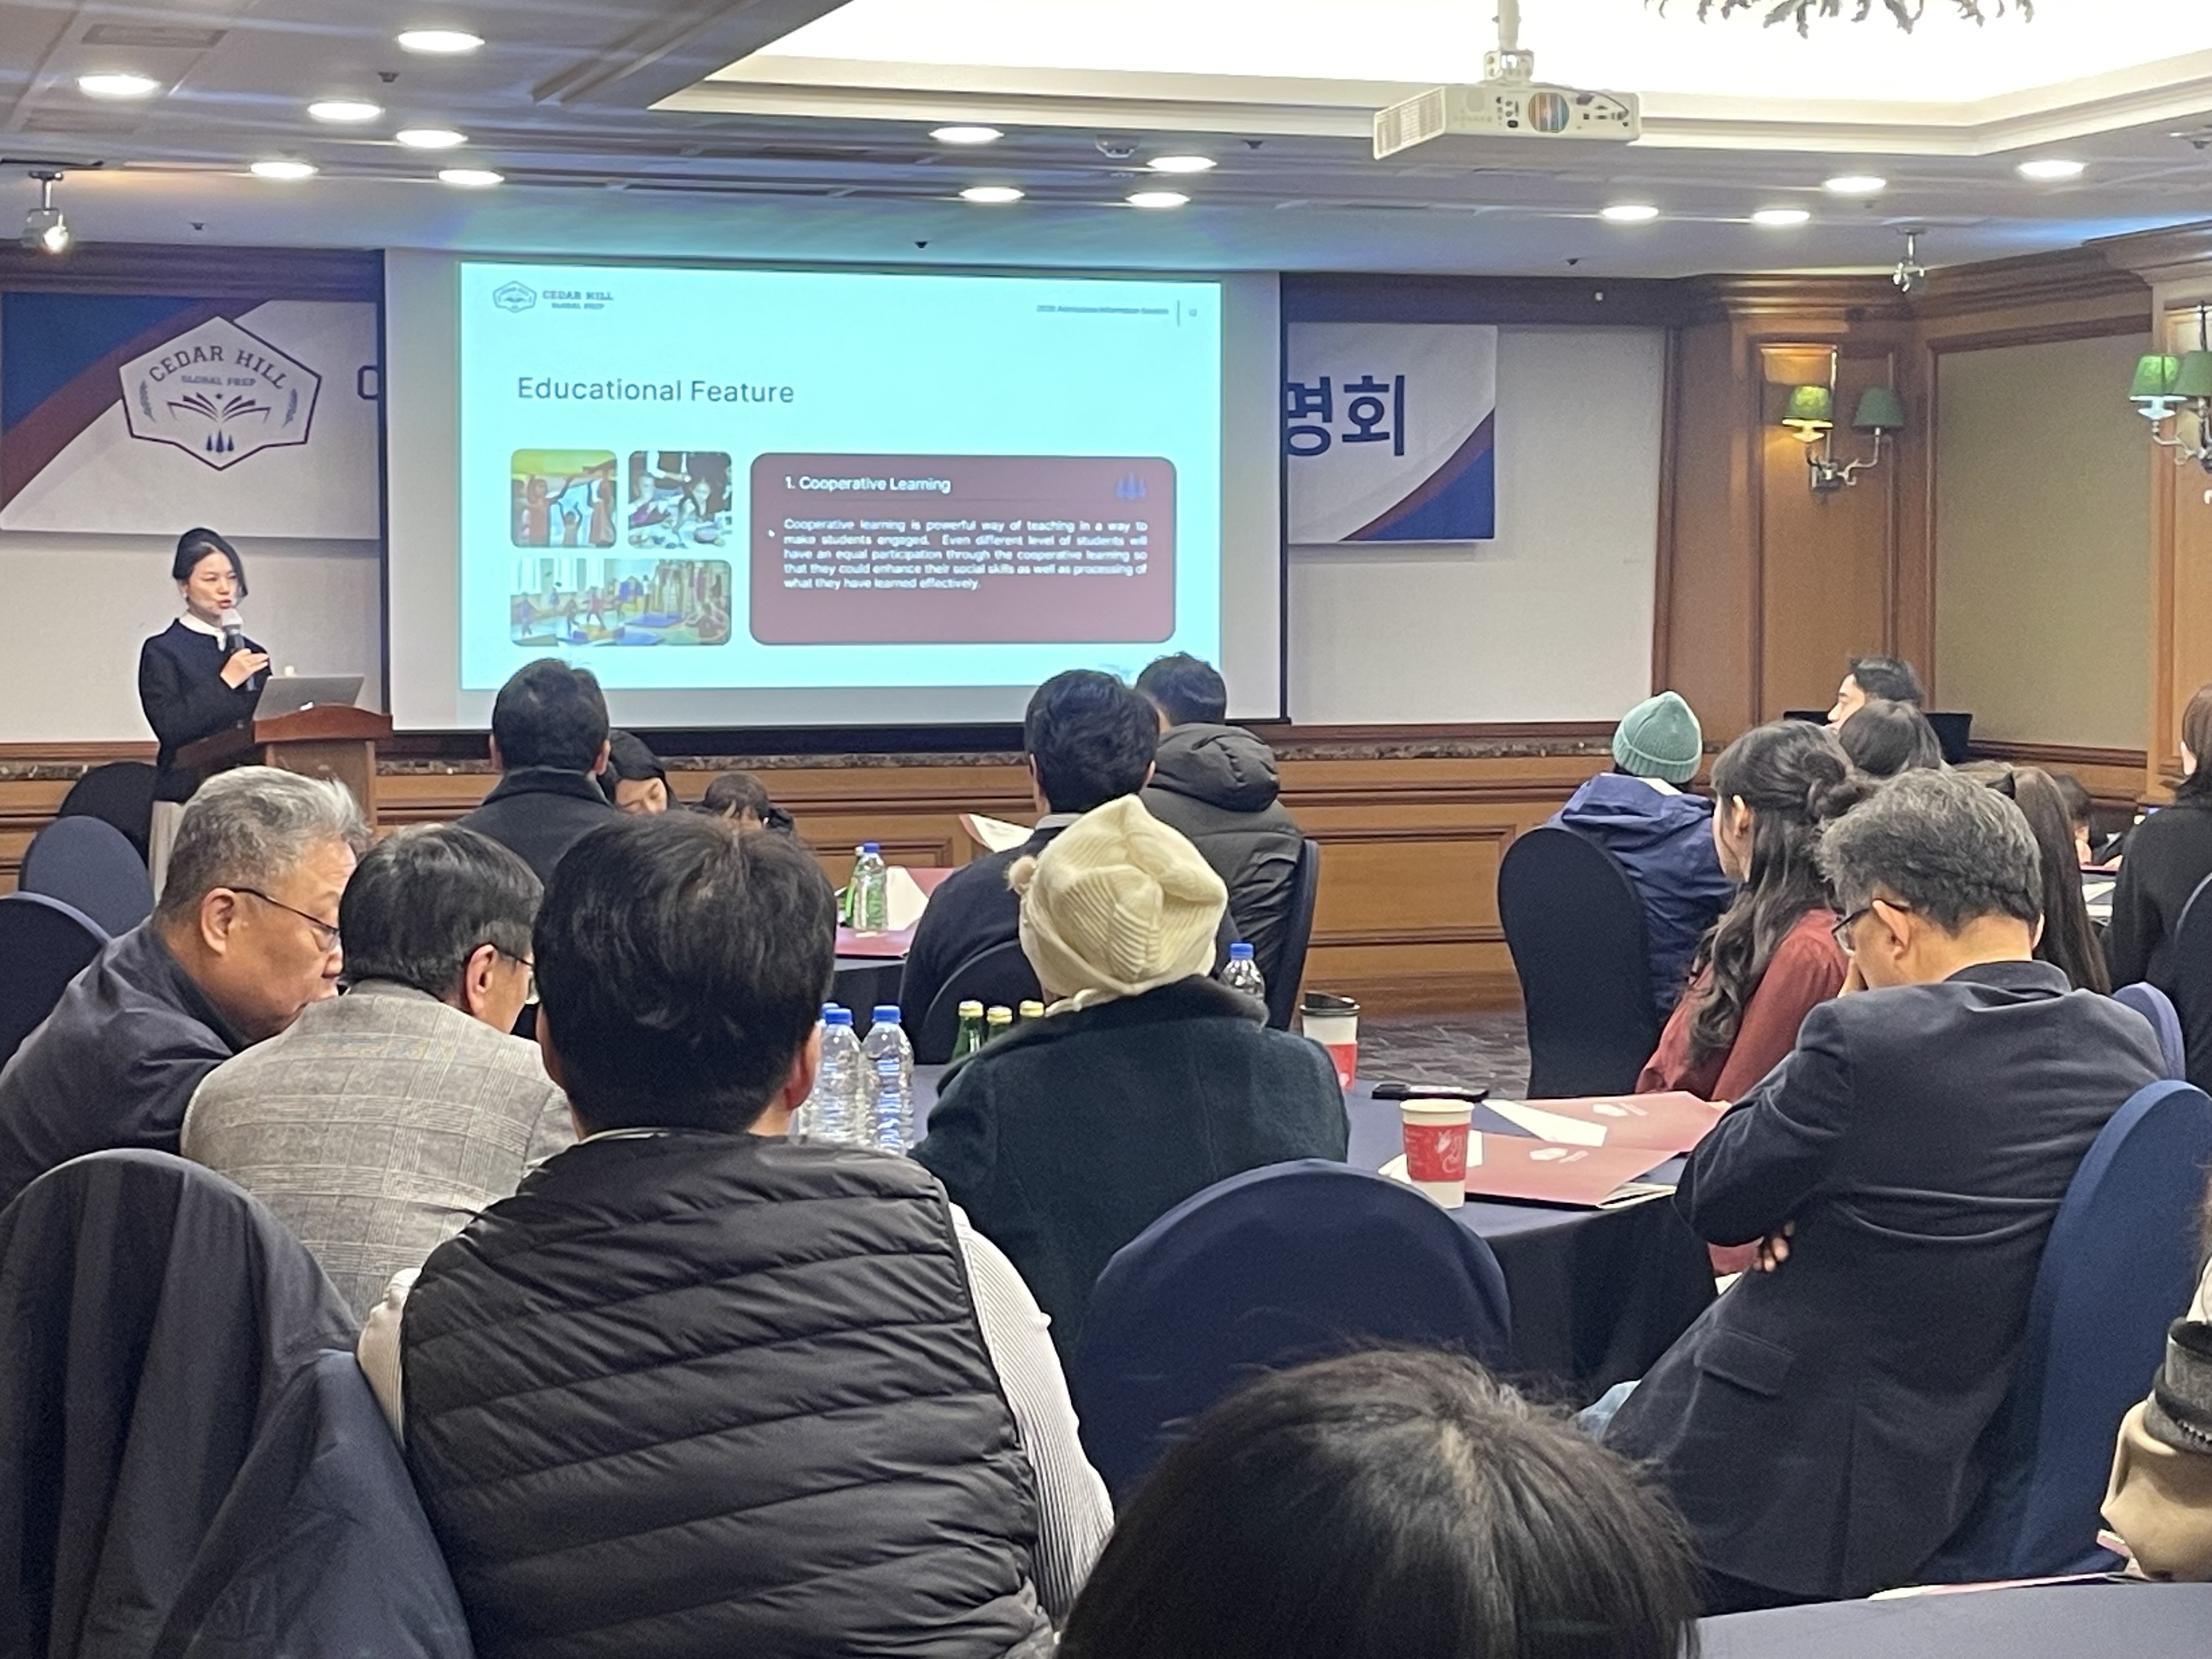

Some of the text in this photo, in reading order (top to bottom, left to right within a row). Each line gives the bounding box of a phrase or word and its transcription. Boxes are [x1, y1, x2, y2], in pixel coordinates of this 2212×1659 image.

[149, 346, 289, 390] CEDAR HILL
[518, 376, 794, 403] Educational Feature
[785, 476, 951, 494] 1. Cooperative Learning
[783, 518, 1148, 533] Cooperative learning is powerful way of teaching in a way to
[783, 536, 816, 544] make
[821, 535, 872, 545] students
[877, 535, 930, 547] engaged.
[941, 534, 971, 545] Even
[975, 535, 1023, 545] different
[1028, 535, 1055, 545] level
[1058, 535, 1071, 545] of
[1076, 537, 1125, 546] students
[783, 549, 813, 558] have
[836, 549, 868, 561] equal
[871, 550, 943, 561] participation
[946, 550, 991, 562] through
[994, 550, 1013, 560] the
[1017, 551, 1082, 561] cooperative
[1086, 550, 1131, 562] learning
[1133, 551, 1148, 560] so
[783, 563, 1148, 575] that they could enhance their social skills as well as processing of
[783, 578, 812, 588] what
[815, 578, 841, 590] they
[843, 578, 872, 588] have
[874, 578, 917, 588] learned
